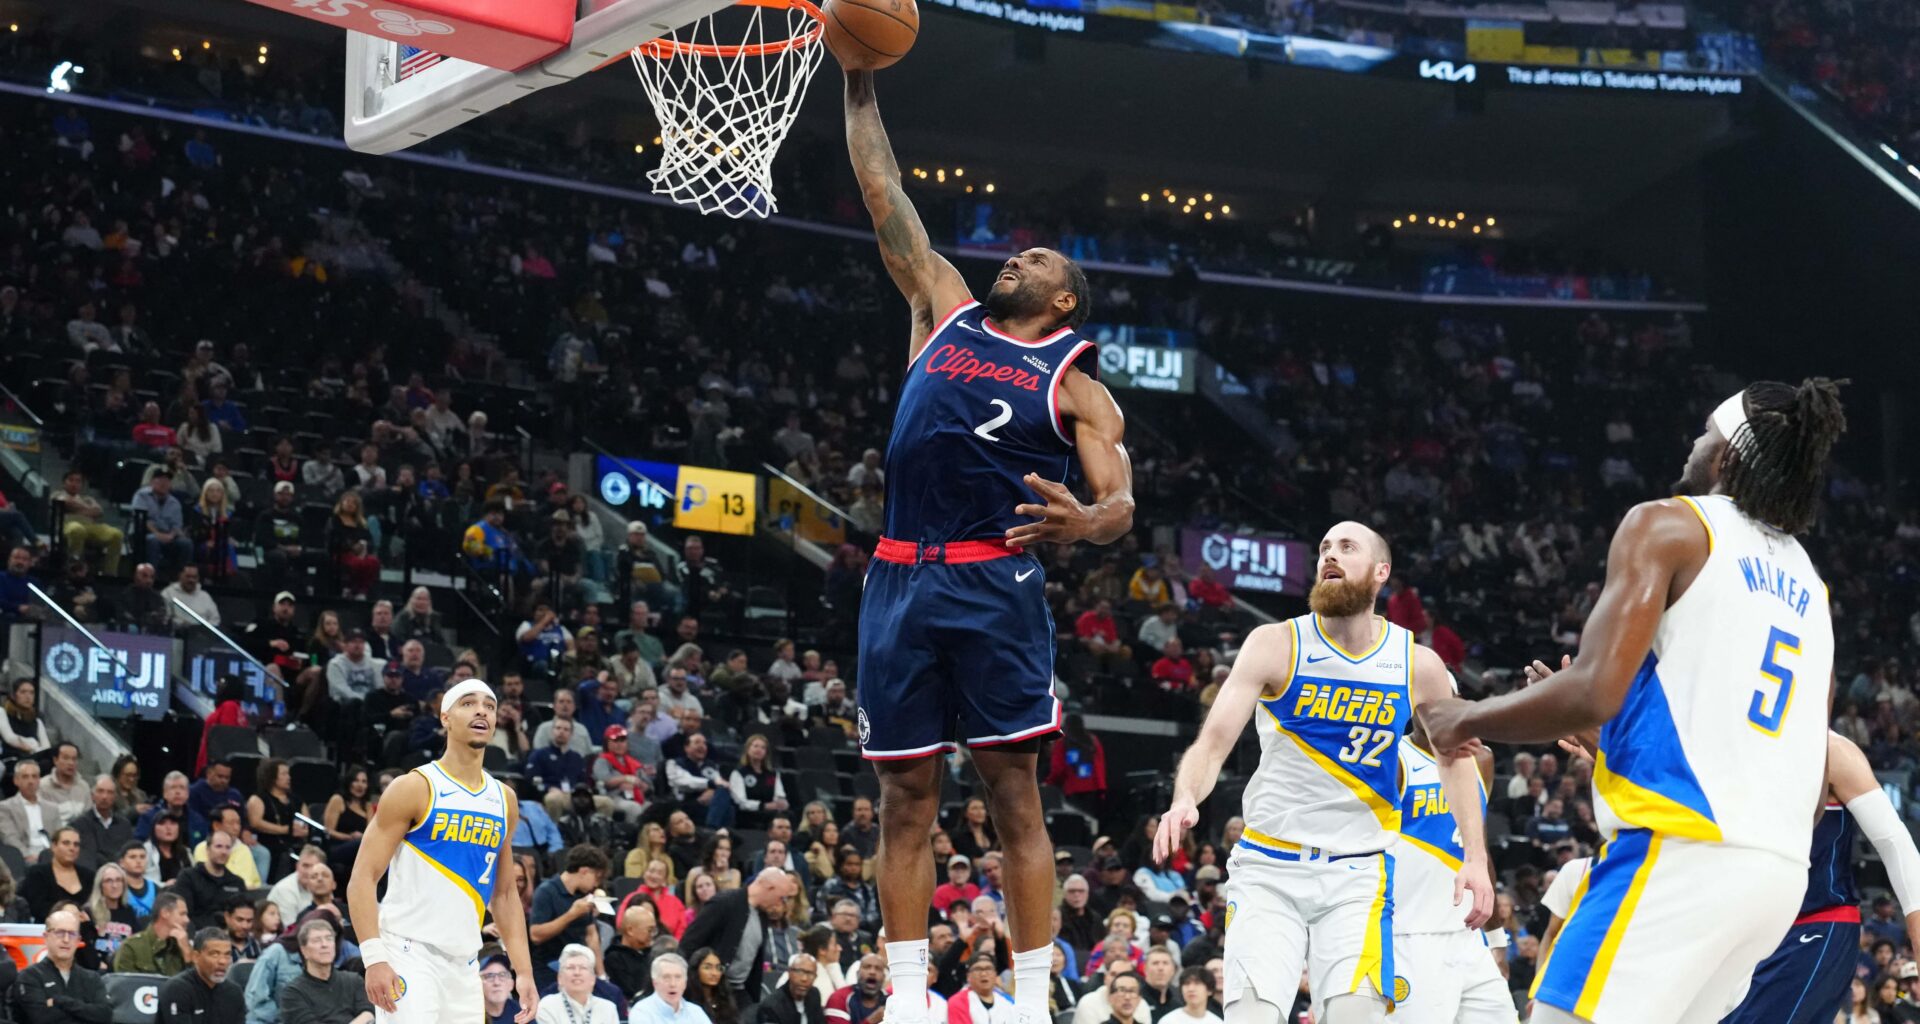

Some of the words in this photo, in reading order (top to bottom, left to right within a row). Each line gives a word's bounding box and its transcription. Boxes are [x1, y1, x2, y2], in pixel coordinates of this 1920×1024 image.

[1506, 66, 1533, 84] The
[1580, 70, 1602, 87] Kia
[1602, 71, 1657, 90] Telluride
[1657, 74, 1742, 95] Turbo-Hybrid
[925, 344, 1040, 391] Clippers
[1022, 354, 1051, 375] RWANDA
[1031, 355, 1049, 368] VISIT
[1127, 346, 1183, 378] FIJI
[974, 398, 1013, 442] 2
[636, 482, 665, 509] 14
[720, 493, 746, 516] 13
[1231, 538, 1287, 576] FIJI
[1738, 556, 1811, 618] WALKER
[87, 646, 166, 689] FIJI
[1747, 625, 1803, 739] 5
[1293, 683, 1401, 726] PACERS
[1338, 725, 1395, 768] 32
[1412, 787, 1450, 819] PAC
[430, 812, 502, 849] PACERS
[478, 851, 497, 885] 2
[133, 985, 159, 1015] G
